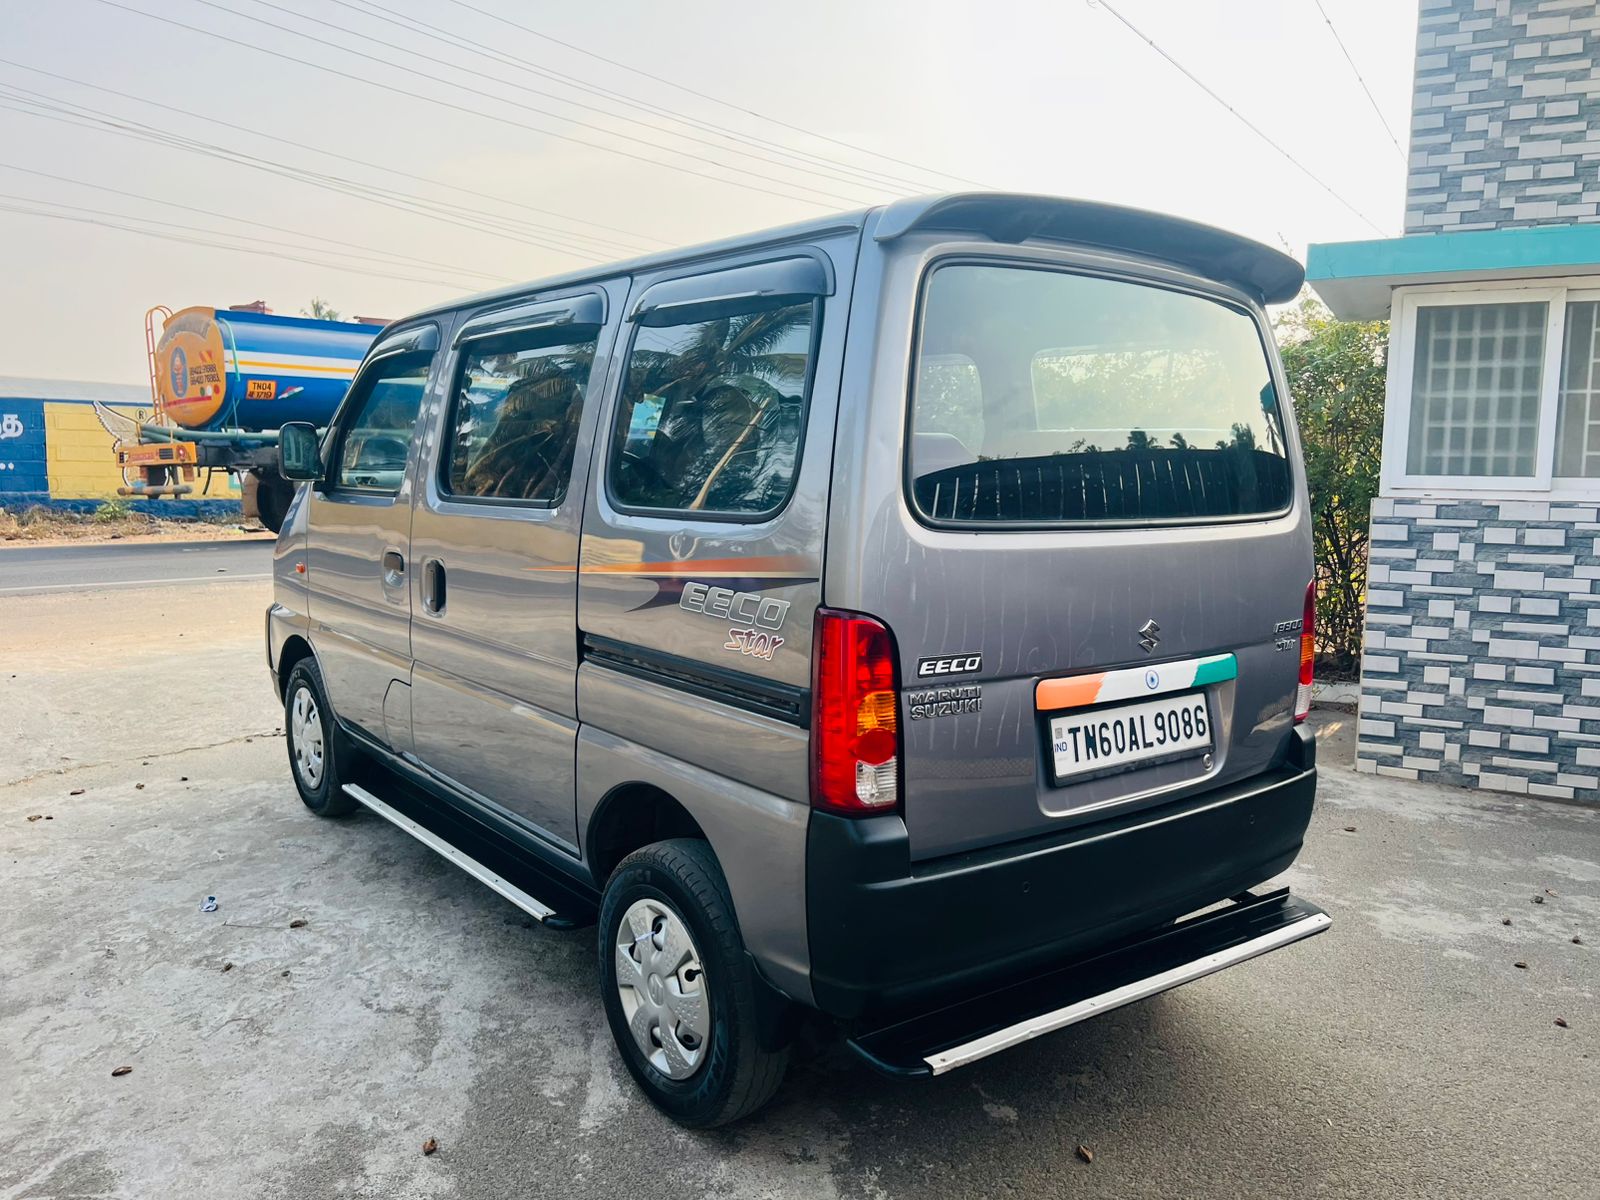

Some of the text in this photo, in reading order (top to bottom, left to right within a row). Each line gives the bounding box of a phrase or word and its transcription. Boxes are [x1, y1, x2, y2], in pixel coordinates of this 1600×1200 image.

[253, 382, 272, 390] TN04
[679, 581, 791, 631] EECO
[723, 628, 784, 661] star
[919, 656, 981, 675] EECO
[908, 685, 982, 705] MARUTI
[911, 697, 983, 720] SUZUKI
[1067, 704, 1206, 763] TN60AL9086
[1054, 741, 1067, 753] IND
